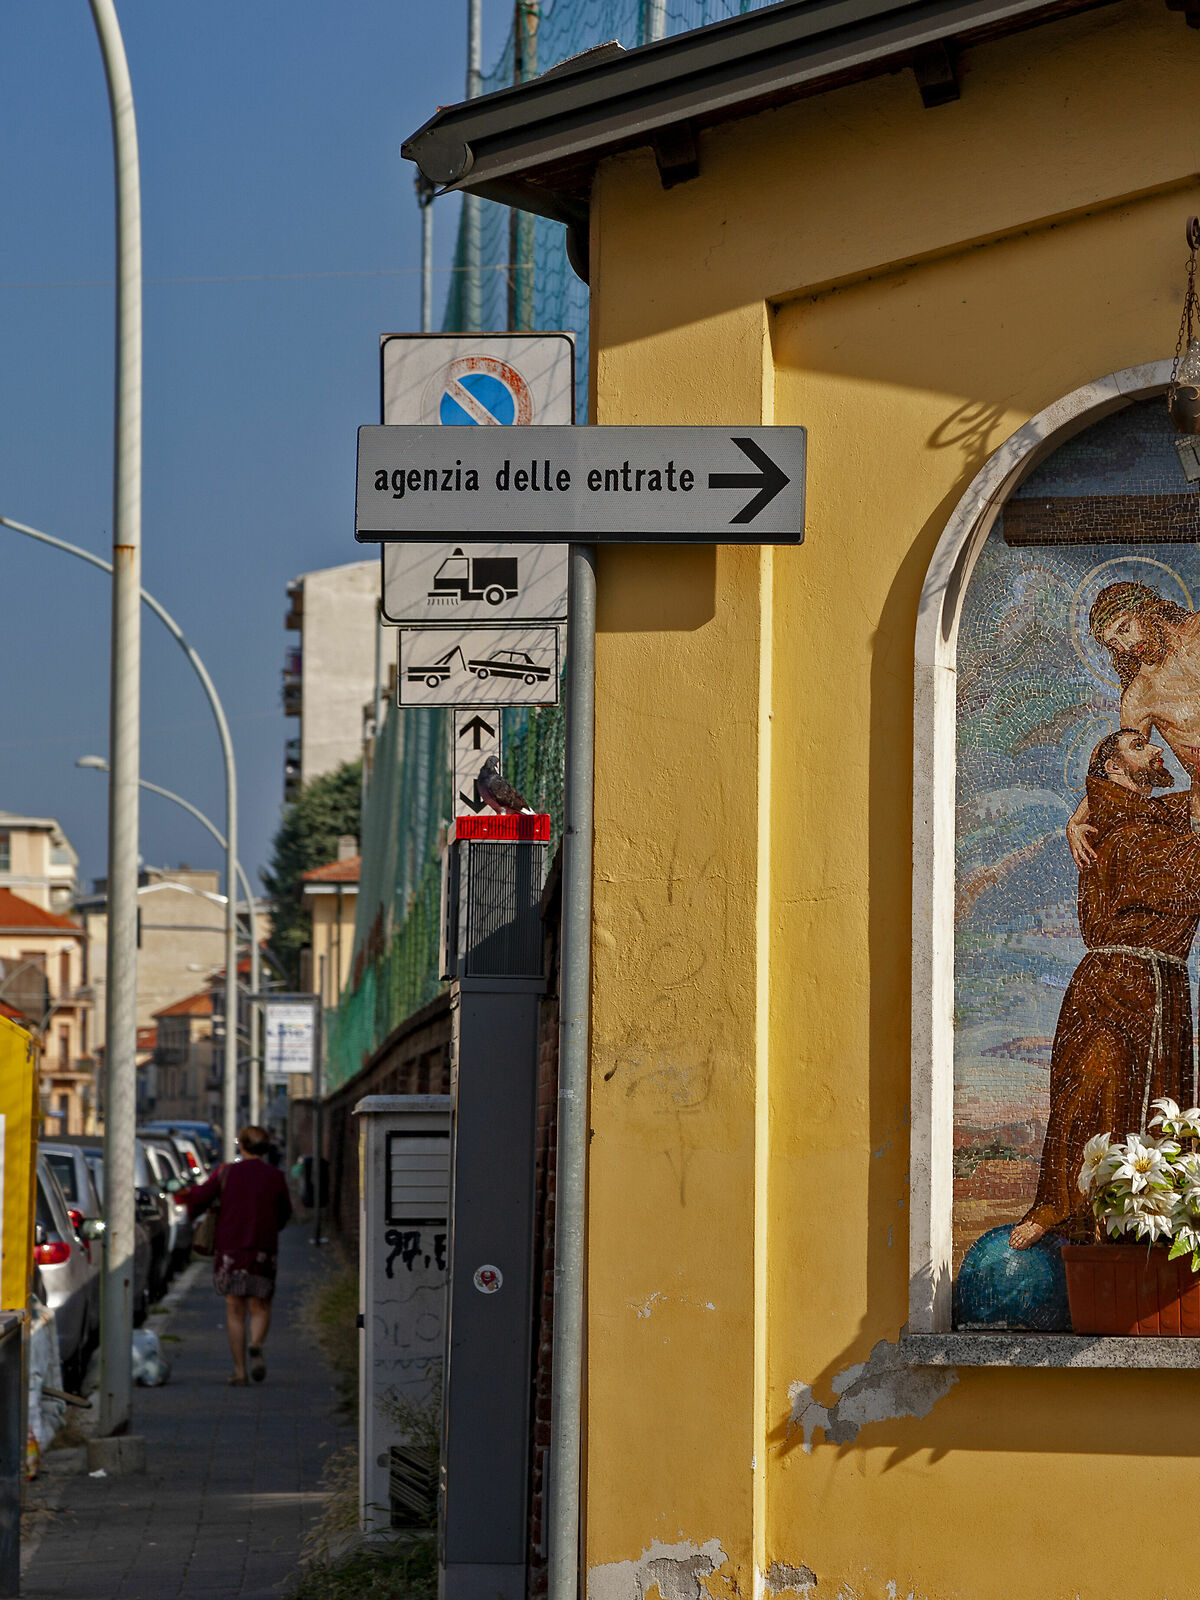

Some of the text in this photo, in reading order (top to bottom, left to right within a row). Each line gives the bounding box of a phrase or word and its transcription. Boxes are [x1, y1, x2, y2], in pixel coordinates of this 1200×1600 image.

[374, 459, 696, 500] agenzia delle entrate
